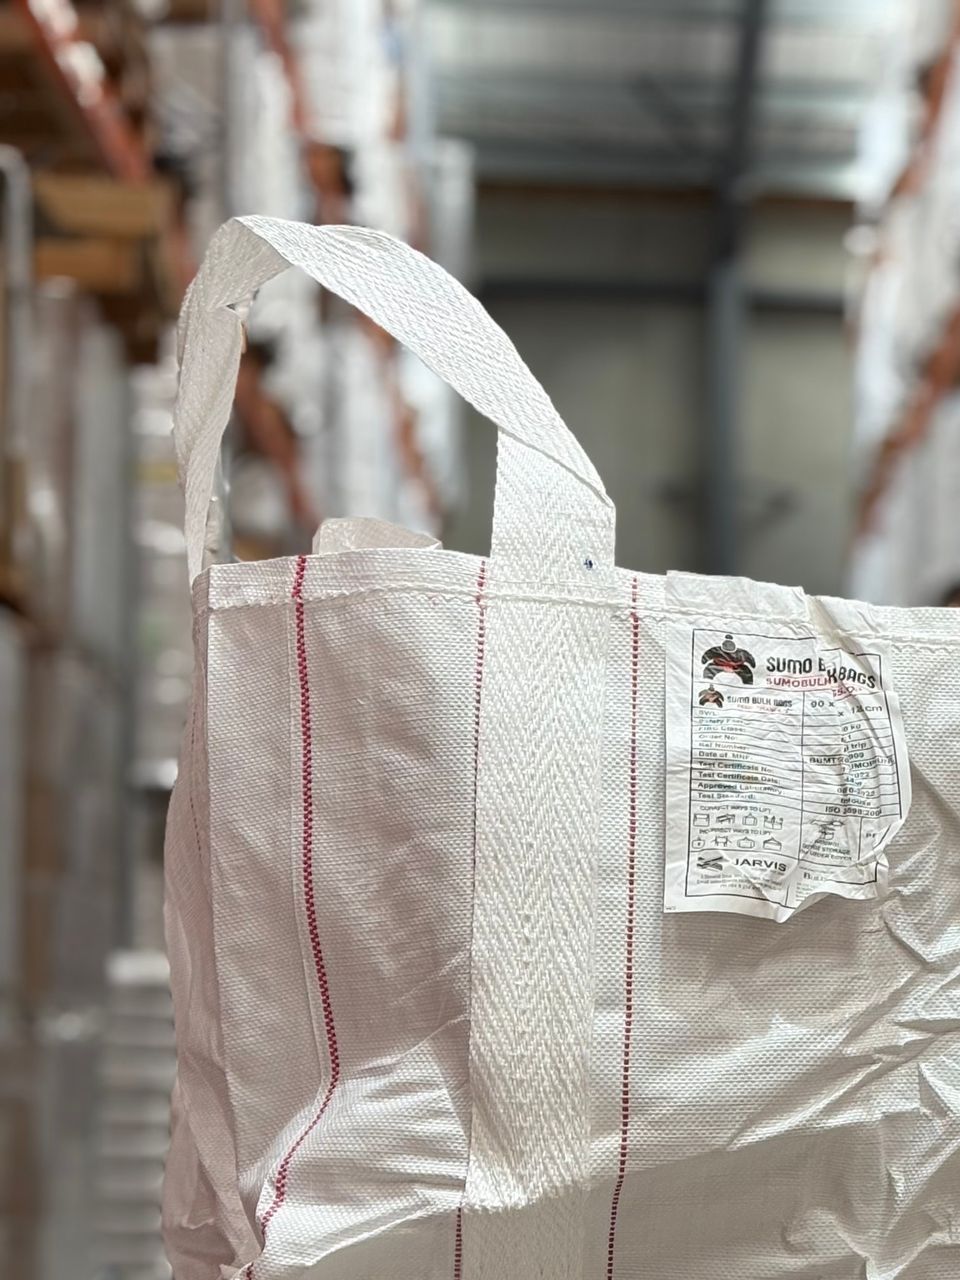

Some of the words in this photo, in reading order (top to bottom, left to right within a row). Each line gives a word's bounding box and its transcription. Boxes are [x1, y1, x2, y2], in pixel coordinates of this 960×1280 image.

[766, 656, 812, 675] SUMO
[838, 666, 876, 689] BAGS
[752, 696, 771, 706] BULK
[717, 762, 759, 771] Certificate
[717, 772, 759, 781] Certificate
[698, 782, 737, 790] Approved
[733, 858, 787, 872] JARVIS
